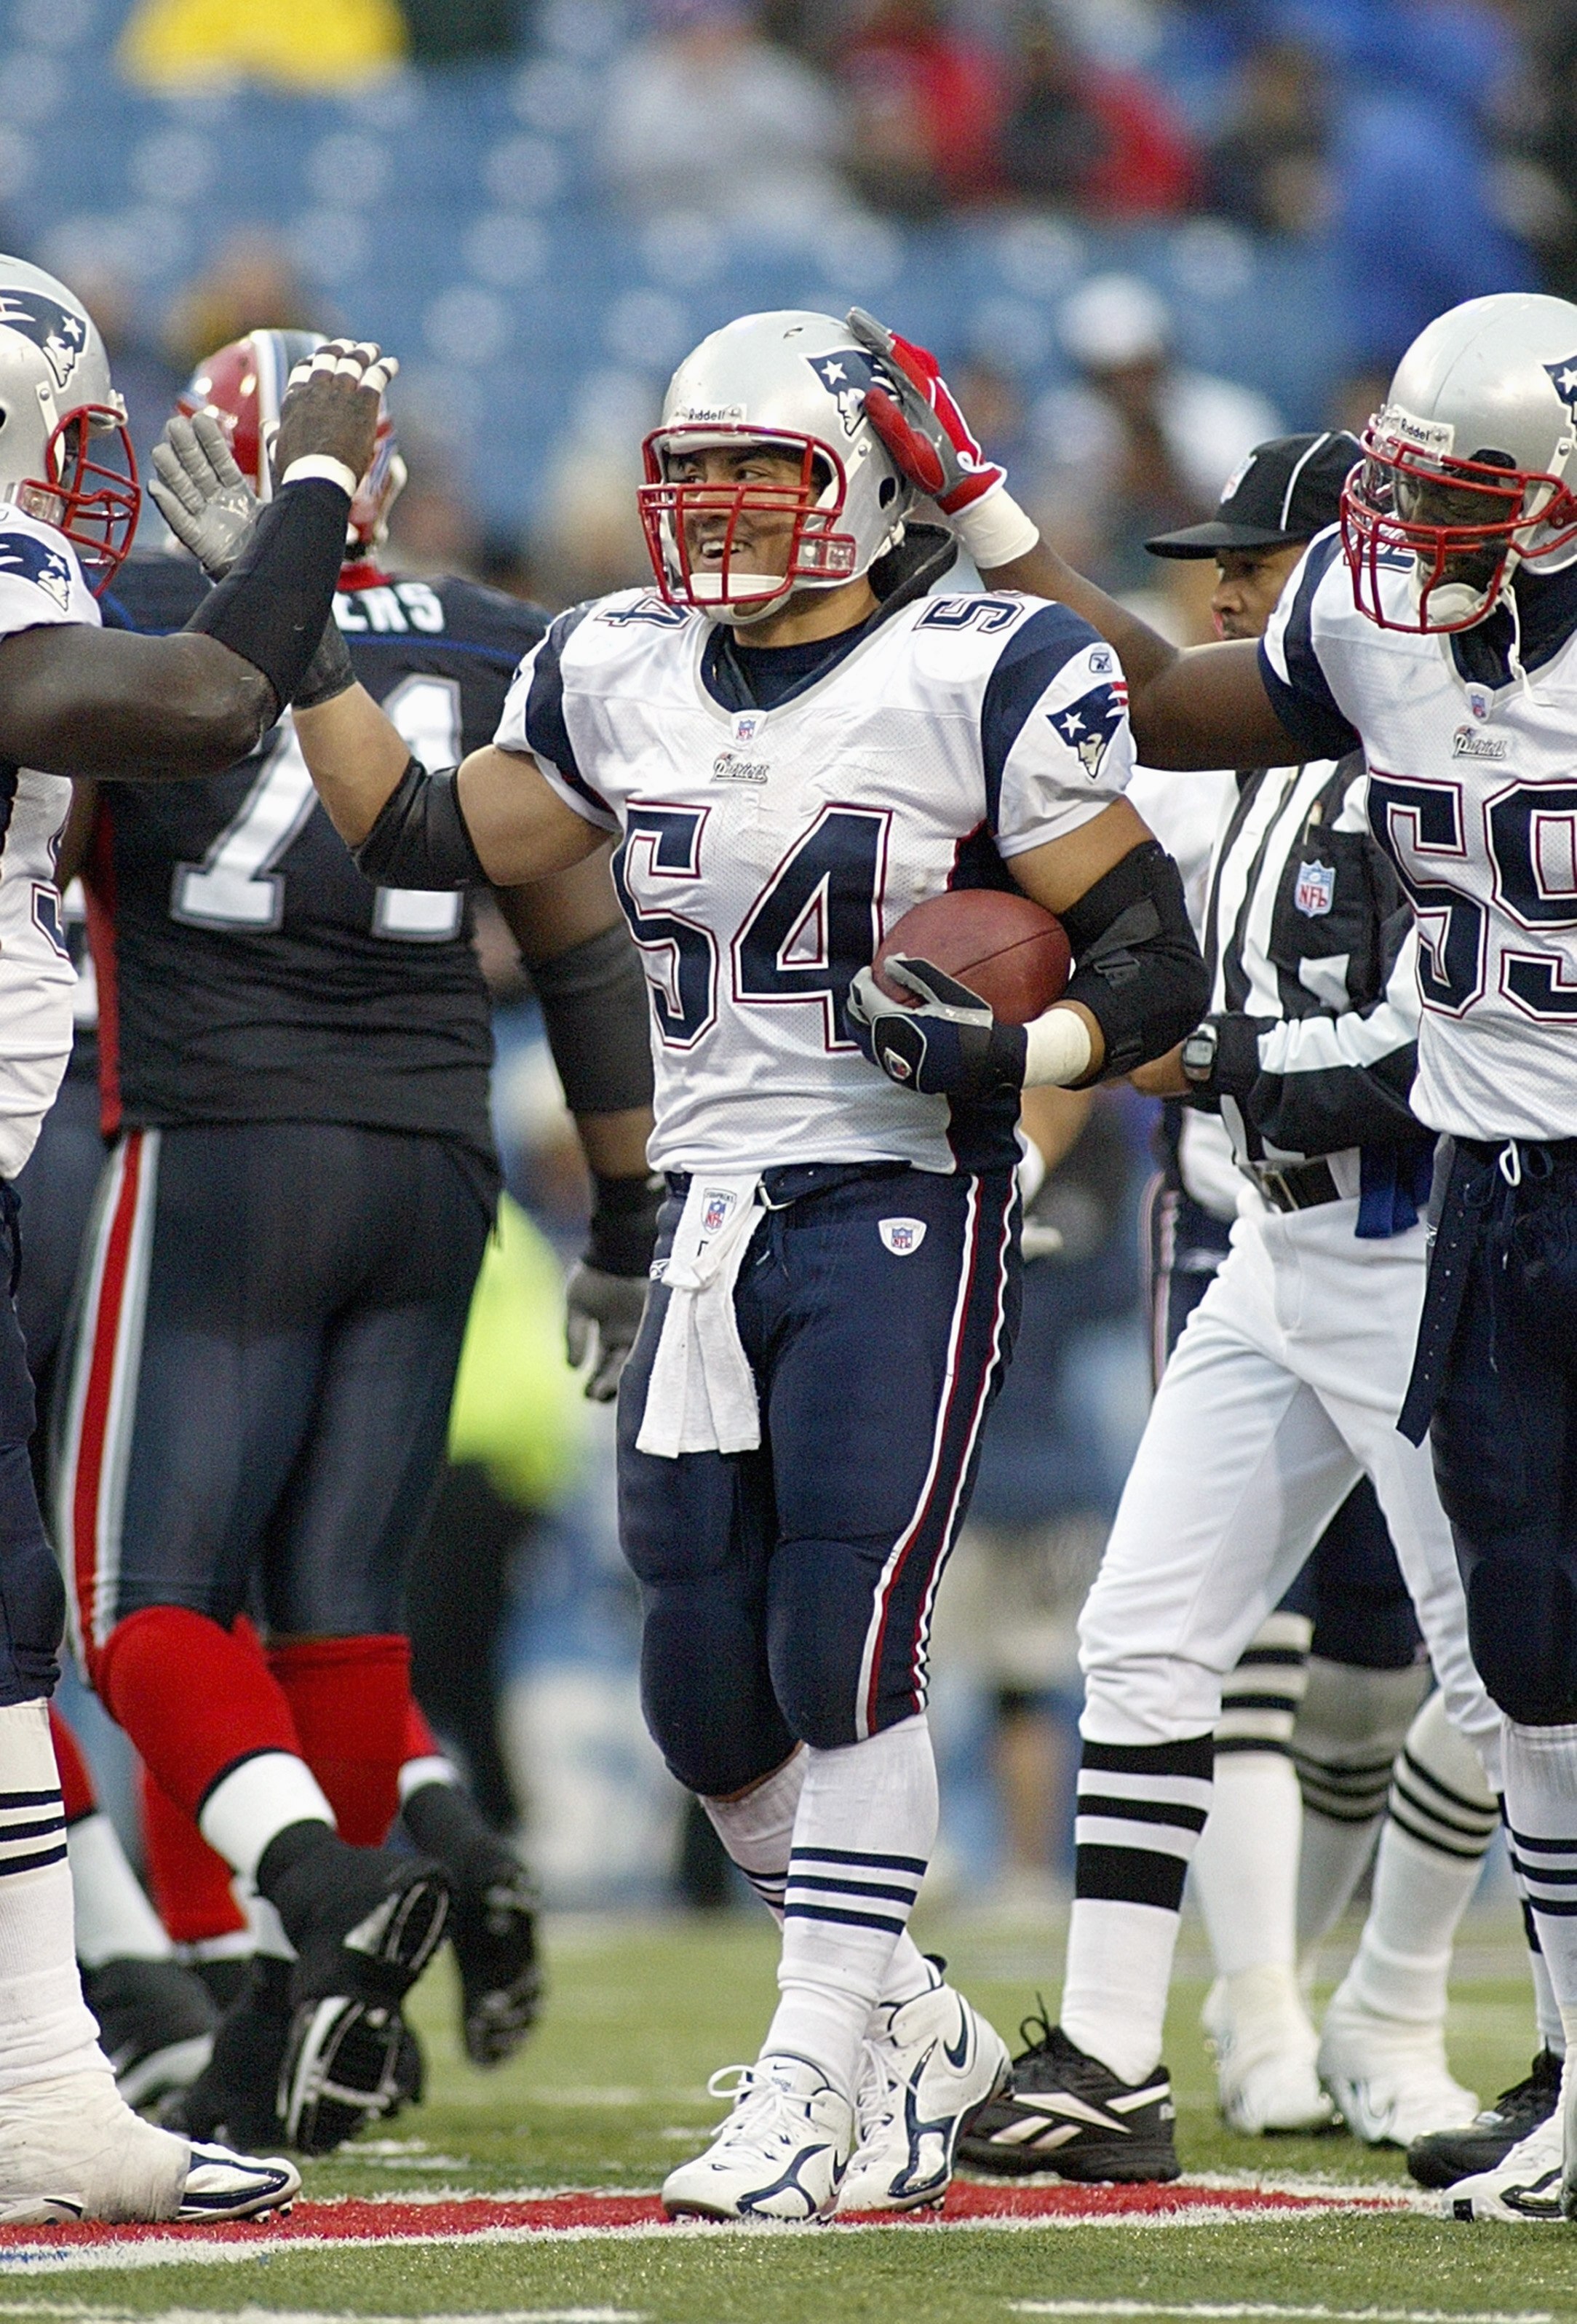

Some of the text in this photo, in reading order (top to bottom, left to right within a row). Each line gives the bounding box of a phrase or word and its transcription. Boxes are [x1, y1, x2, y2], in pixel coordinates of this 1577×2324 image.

[1401, 418, 1432, 441] Riddel
[610, 798, 894, 1052] 54
[1299, 884, 1328, 910] NFL
[1365, 767, 1577, 1022] 59
